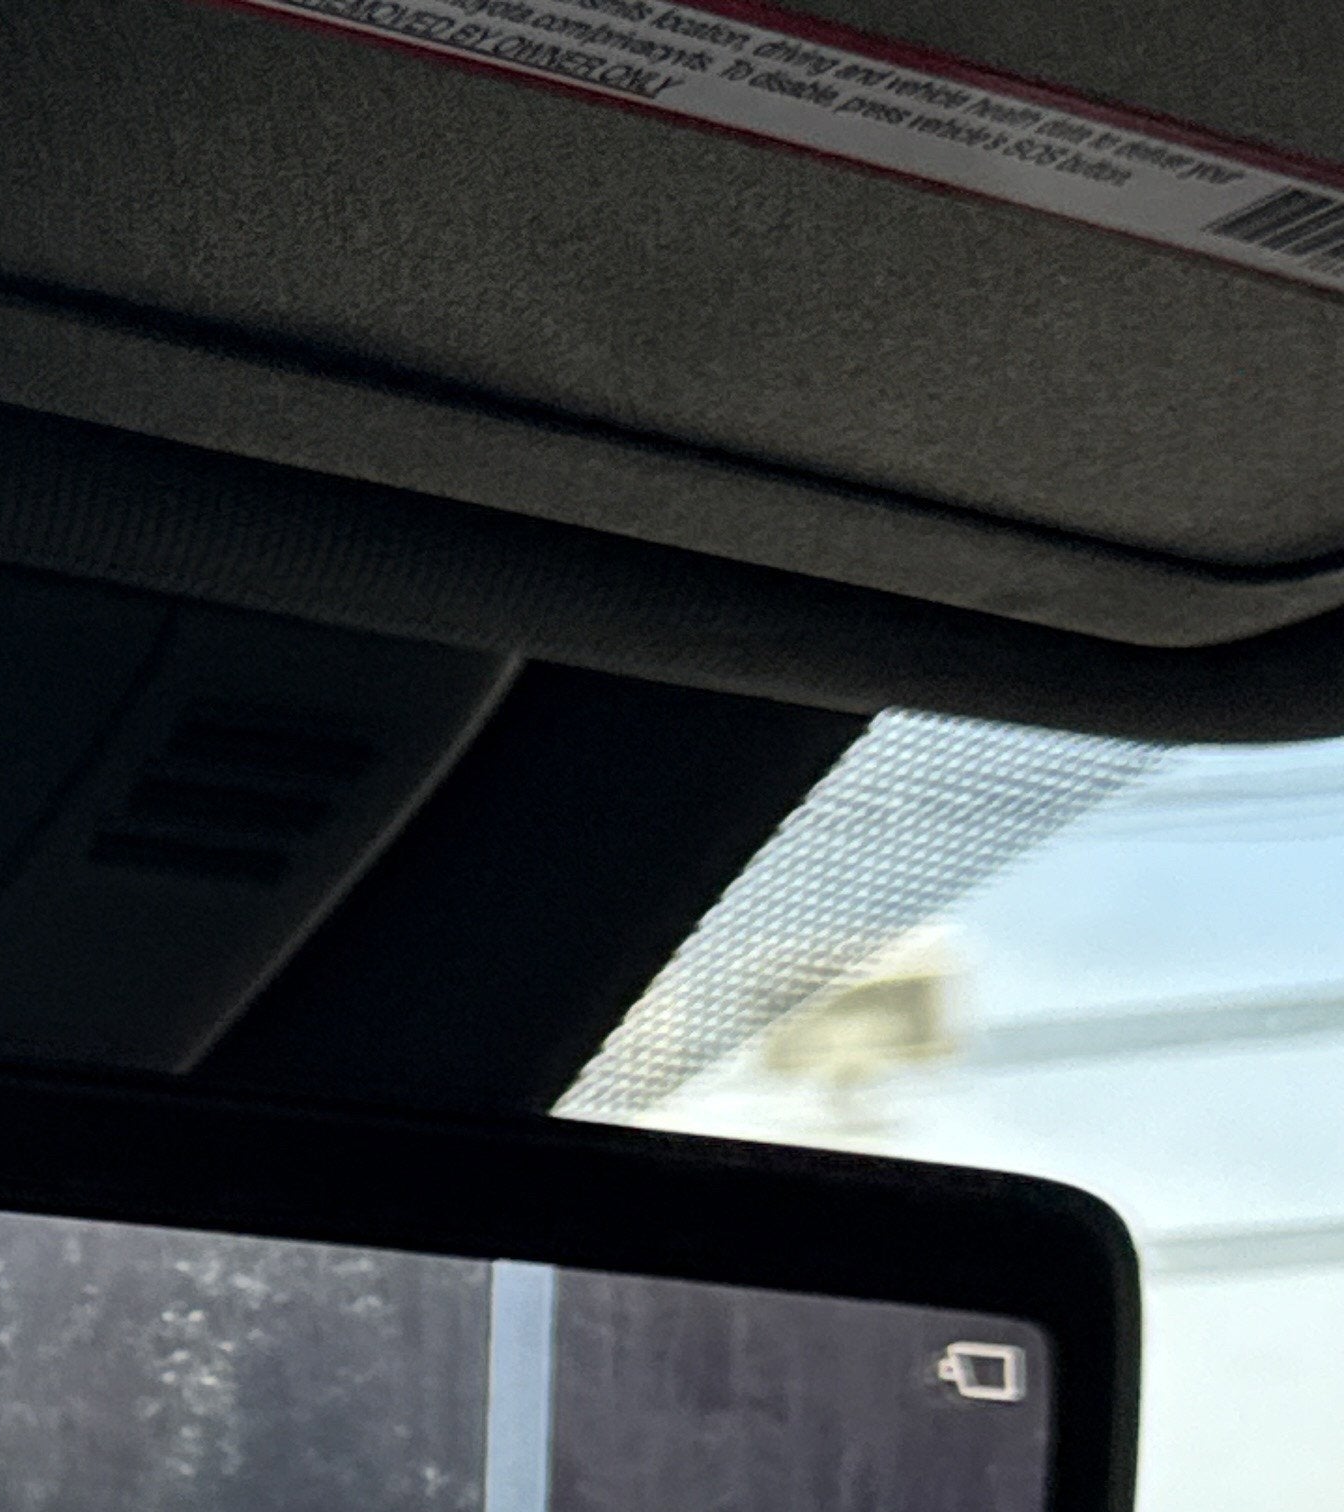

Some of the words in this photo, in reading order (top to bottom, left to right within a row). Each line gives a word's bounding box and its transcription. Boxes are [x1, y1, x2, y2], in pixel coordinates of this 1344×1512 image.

[449, 23, 503, 50] BY
[493, 35, 608, 76] OWNER
[598, 65, 687, 96] ONLY
[833, 97, 912, 125] press
[1001, 138, 1069, 166] SOS
[834, 64, 896, 86] and
[884, 77, 972, 109] vehicle
[1175, 161, 1245, 184] your
